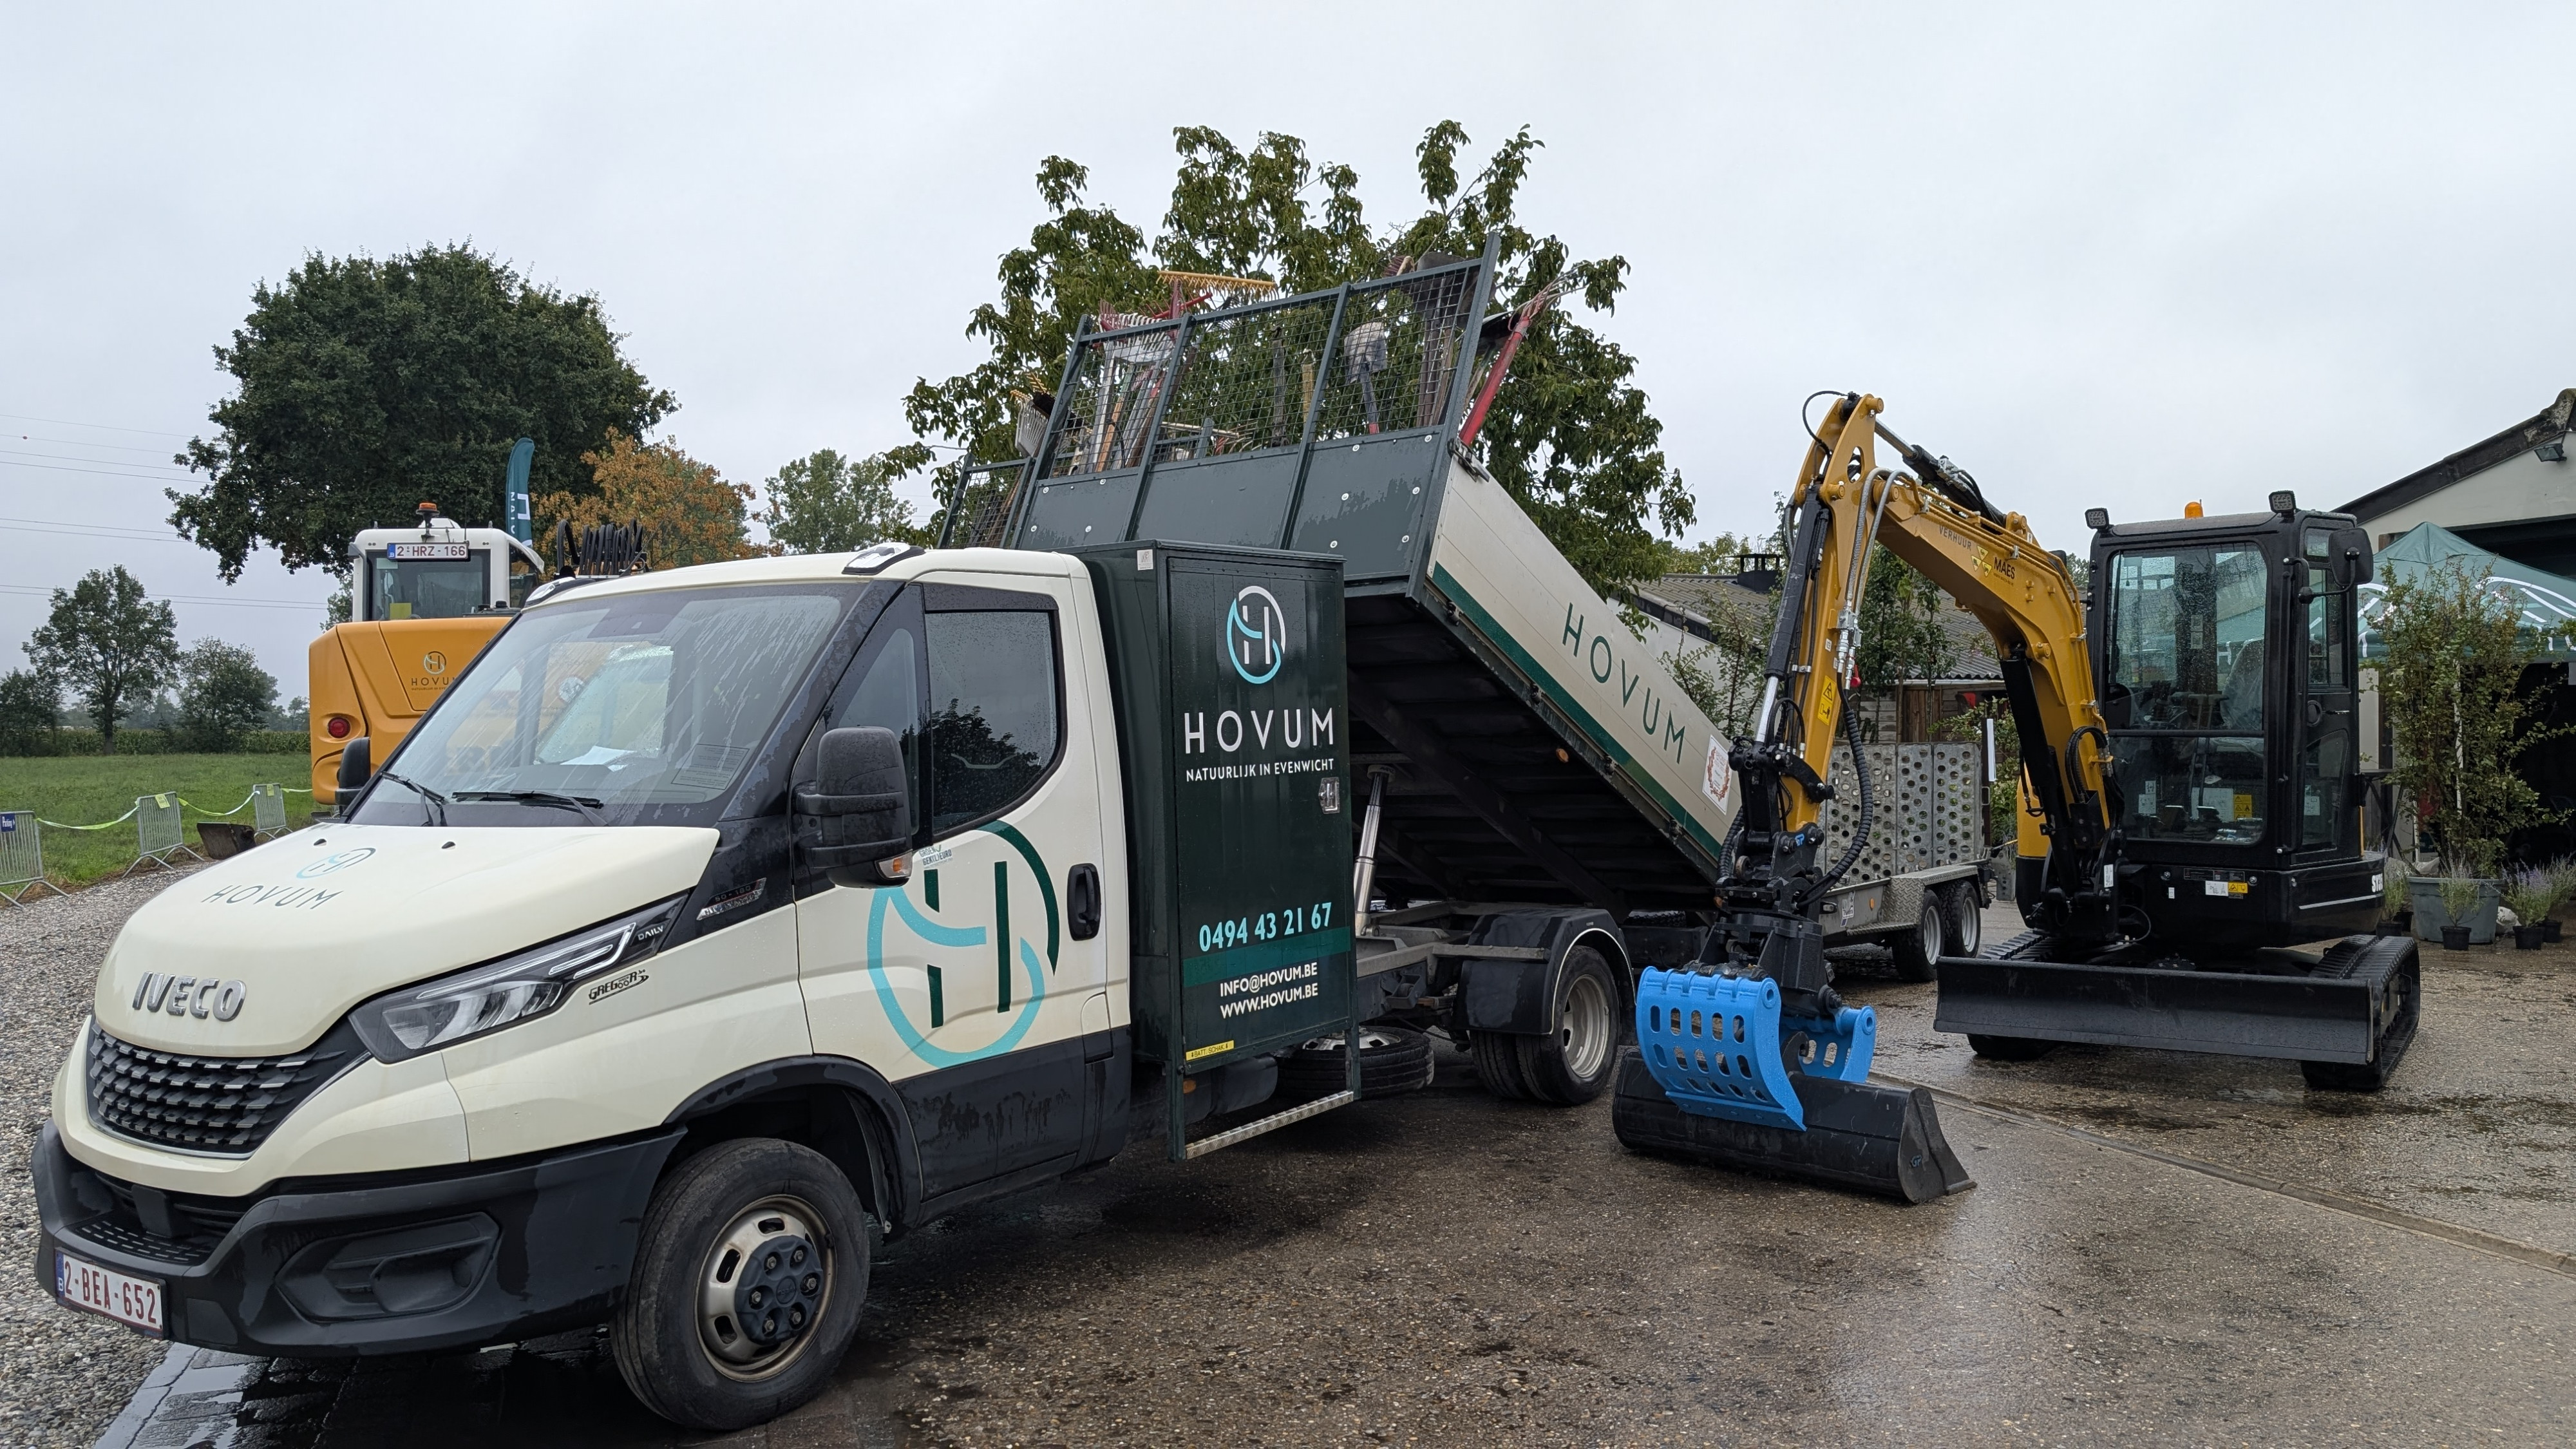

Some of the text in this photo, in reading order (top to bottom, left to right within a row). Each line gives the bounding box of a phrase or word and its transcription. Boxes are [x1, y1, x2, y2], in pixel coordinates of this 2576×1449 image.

[1939, 524, 1972, 551] VERHUUR
[1994, 556, 2015, 580] MAES
[412, 677, 455, 686] HOVU
[1562, 602, 1685, 764] HOVUM
[1184, 708, 1334, 754] HOVUM
[1186, 758, 1334, 782] NATUURLIJK IN EVENWICHT
[201, 884, 345, 910] HOVUM
[638, 925, 664, 941] DAILY
[1199, 902, 1332, 952] 0494 43 21 67
[1220, 962, 1318, 998] INFO@HOVUM.BE
[131, 971, 247, 1022] IVECO
[1220, 983, 1318, 1019] WWW.HOVUM.BE
[58, 1277, 64, 1292] B
[65, 1261, 156, 1324] 2-BEA-652
